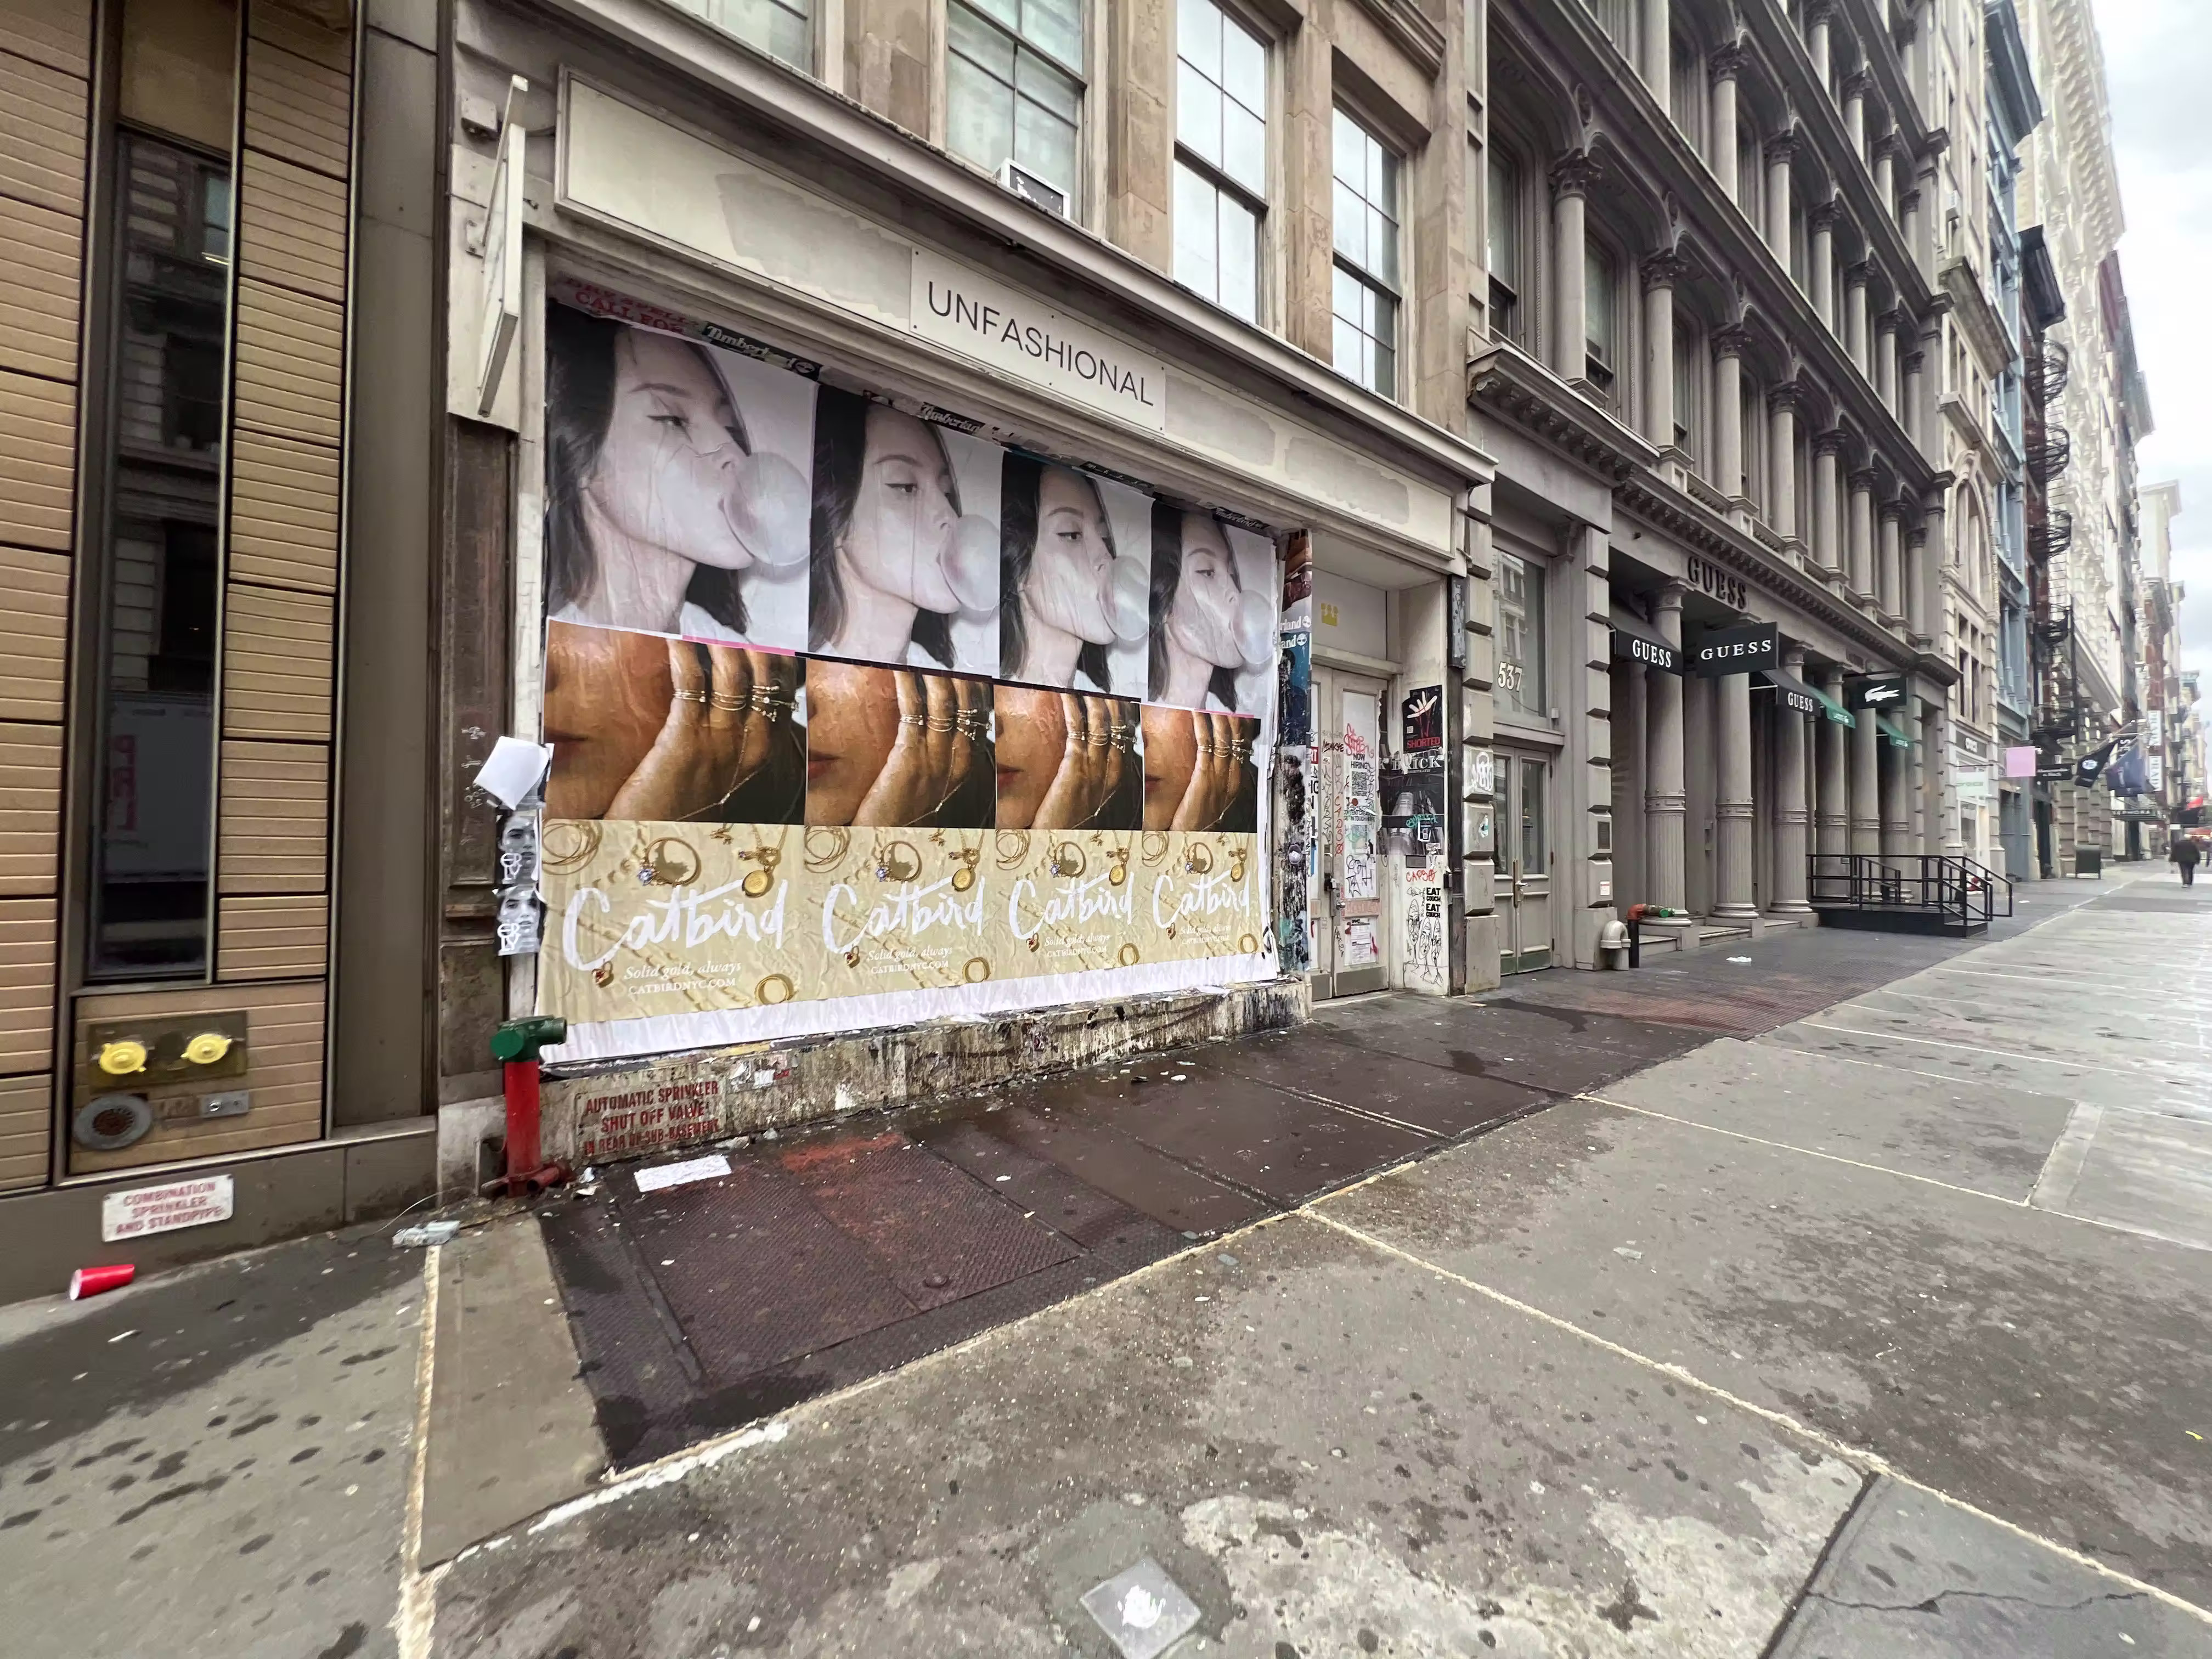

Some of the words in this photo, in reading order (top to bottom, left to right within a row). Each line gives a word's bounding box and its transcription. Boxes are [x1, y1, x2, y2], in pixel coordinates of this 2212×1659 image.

[928, 281, 1154, 407] UNFASHIONAL
[1687, 556, 1747, 610] GUESS
[1632, 639, 1672, 668] GUESS
[1700, 639, 1772, 661] GUESS
[1497, 661, 1523, 692] 537
[1787, 692, 1813, 712] GUESS
[1407, 737, 1440, 748] SHORTED
[1153, 870, 1250, 929] Catbird
[1426, 887, 1441, 896] EAT
[822, 877, 985, 954] Catbird
[1009, 872, 1134, 940] Catbird
[1426, 903, 1441, 912] EAT
[562, 879, 788, 971] Catbird
[1045, 935, 1065, 946] Solid
[1085, 932, 1110, 944] always
[867, 949, 894, 961] Solid
[920, 945, 953, 958] always
[624, 964, 660, 980] Solid
[660, 962, 694, 980] gold,
[697, 960, 742, 975] always
[628, 978, 736, 995] CATBIRDNYC.COM
[585, 1089, 654, 1114] AUTOMATIC
[600, 1111, 636, 1133] SHUT
[640, 1108, 664, 1126] OFF
[668, 1102, 706, 1121] VALVE
